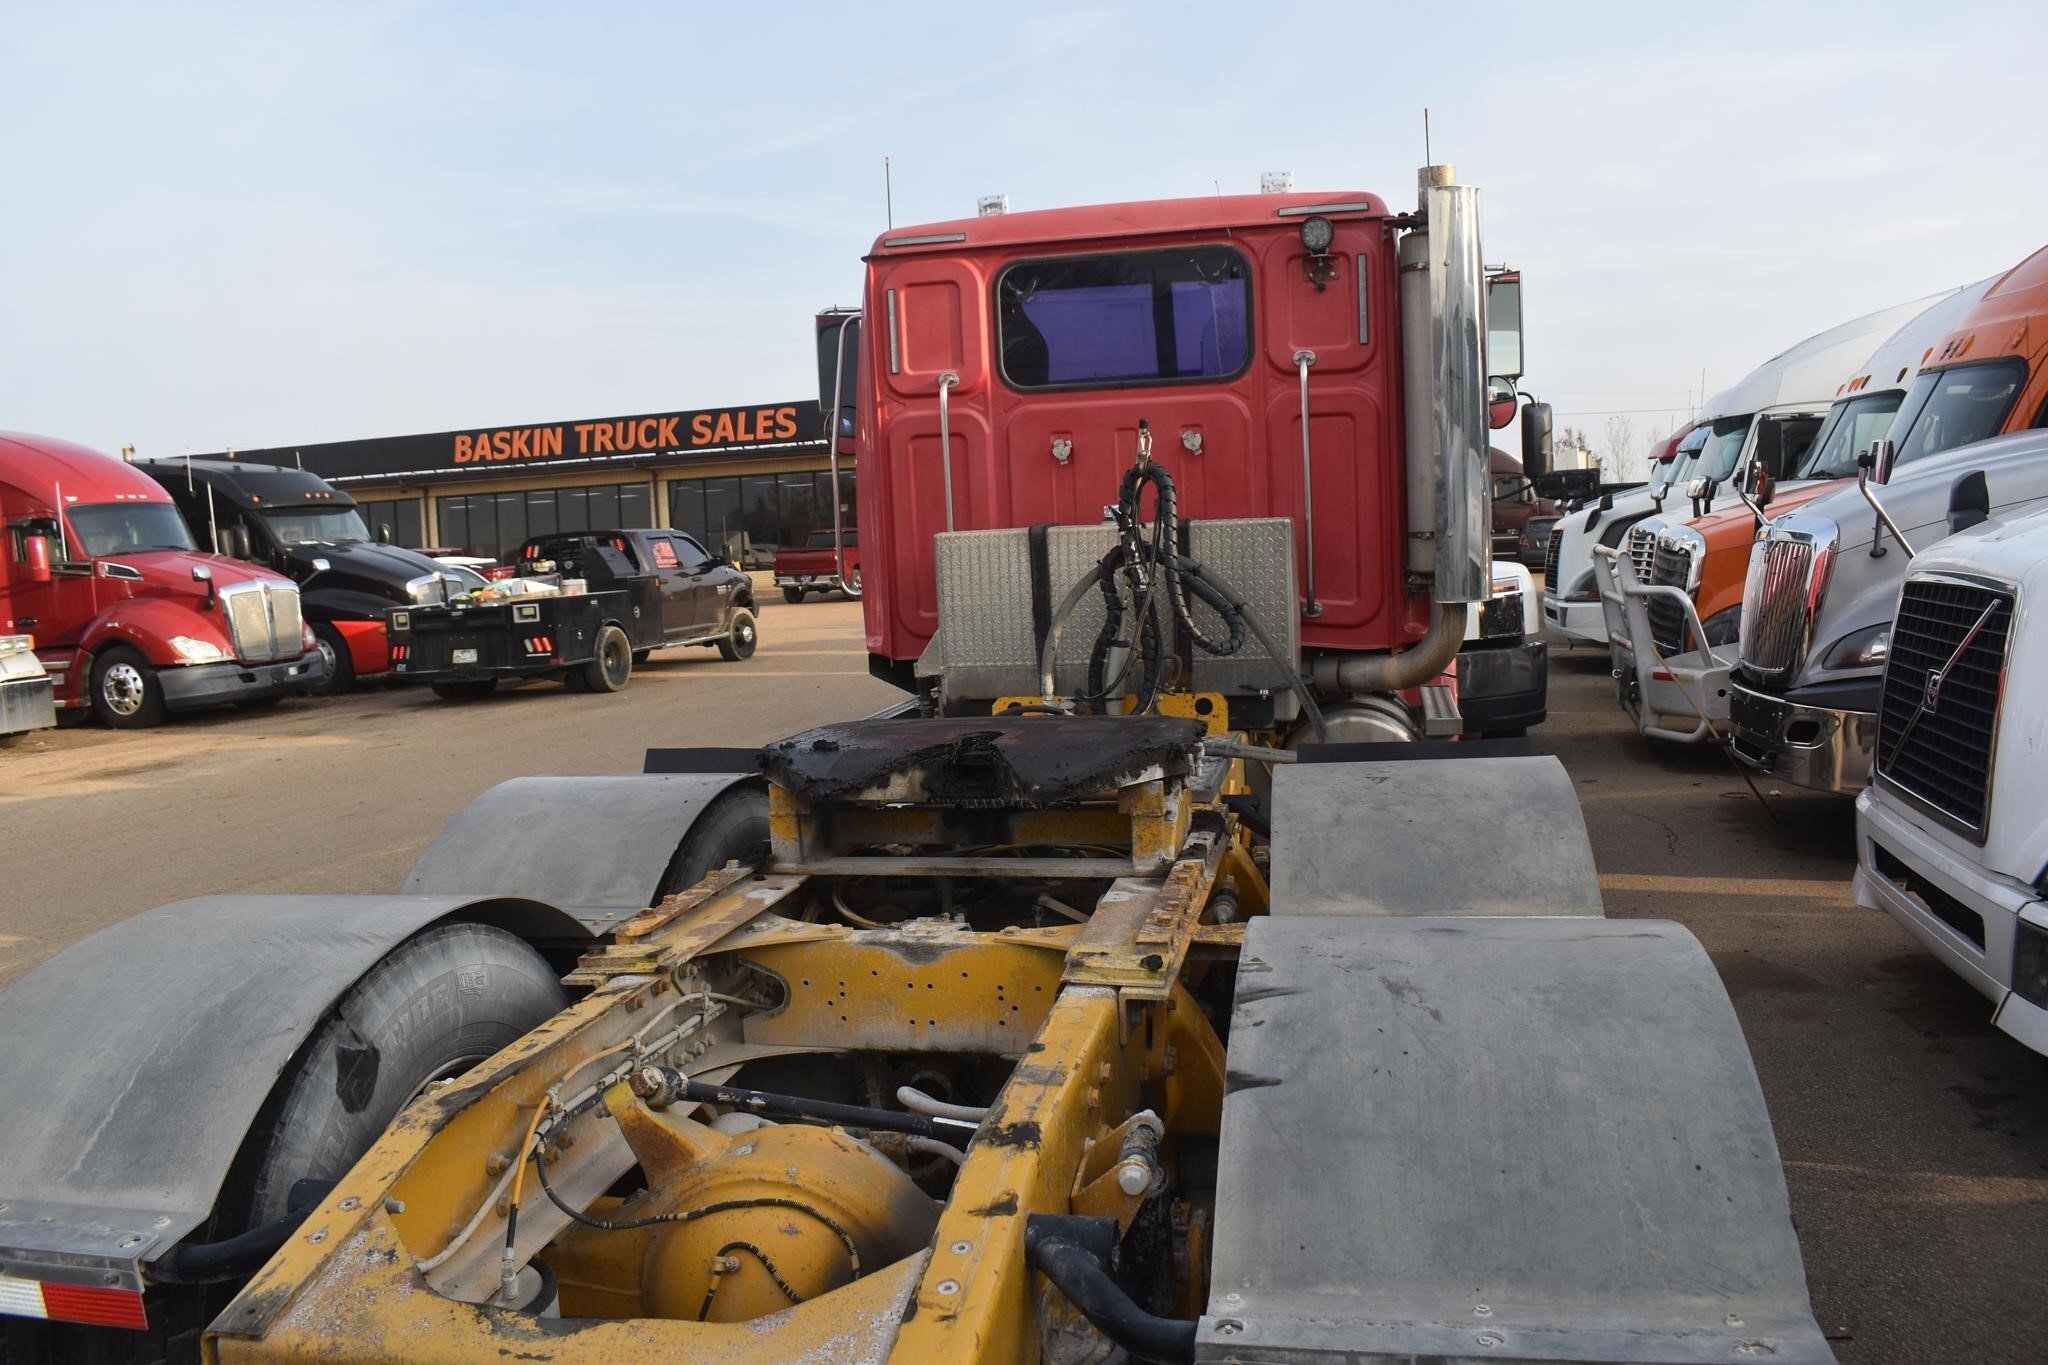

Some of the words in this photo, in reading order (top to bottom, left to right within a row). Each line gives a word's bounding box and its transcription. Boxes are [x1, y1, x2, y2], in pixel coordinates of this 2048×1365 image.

[454, 426, 563, 463] BASKIN
[574, 417, 680, 453] TRUCK
[691, 407, 797, 444] SALES
